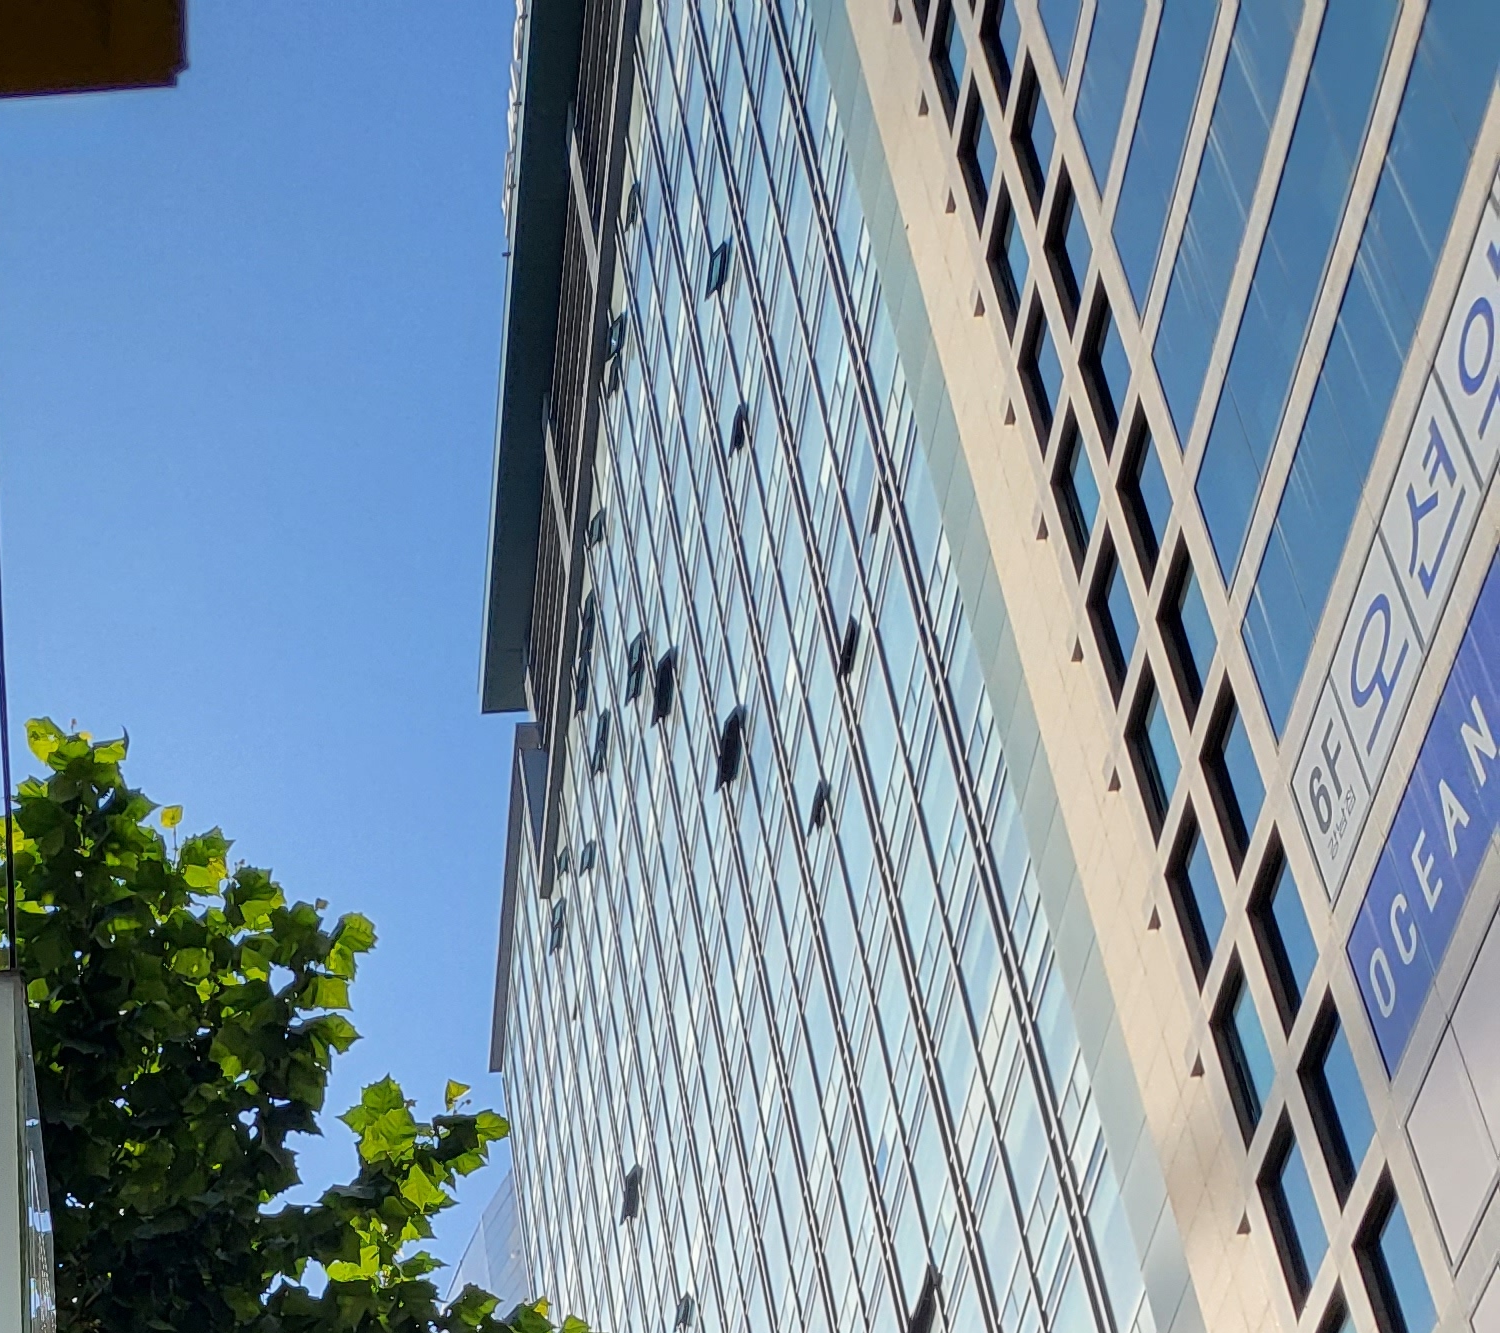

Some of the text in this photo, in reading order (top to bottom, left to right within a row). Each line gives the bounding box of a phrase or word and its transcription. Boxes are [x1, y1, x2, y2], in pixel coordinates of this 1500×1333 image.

[1308, 717, 1342, 835] 6F
[1328, 783, 1356, 861] 강남점
[1369, 694, 1497, 1018] OCEAN
